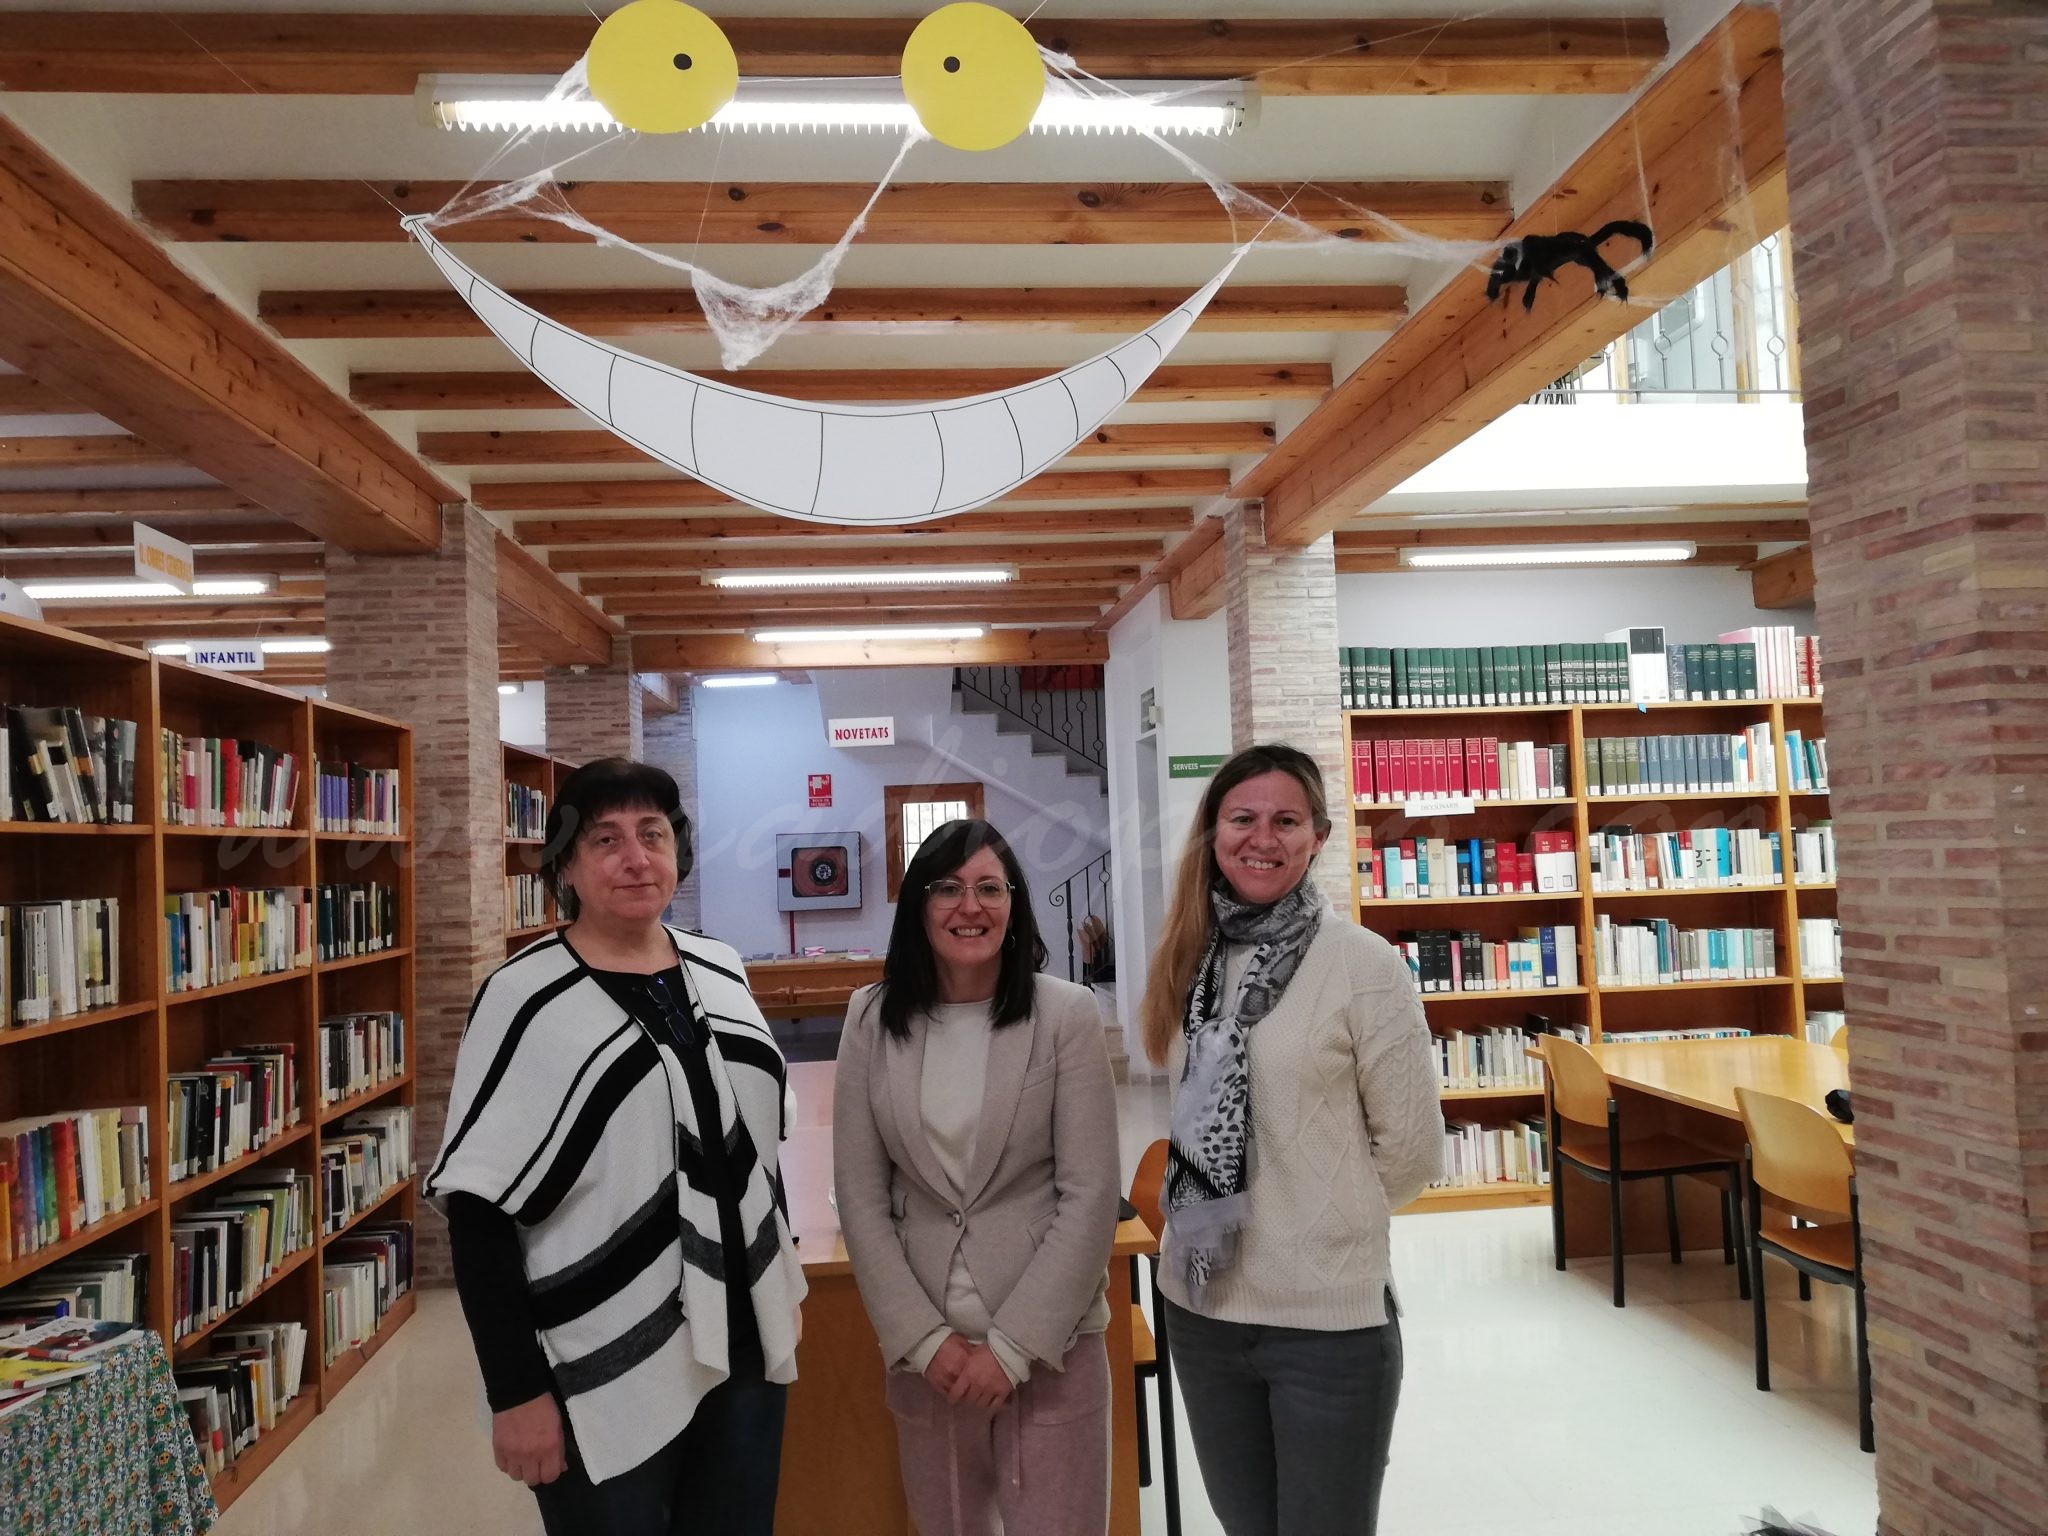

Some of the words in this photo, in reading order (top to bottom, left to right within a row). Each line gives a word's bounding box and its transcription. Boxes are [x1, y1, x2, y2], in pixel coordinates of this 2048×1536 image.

[194, 650, 256, 664] INFANTIL
[835, 727, 889, 740] NOVETATS
[1172, 762, 1199, 771] SERVEIS
